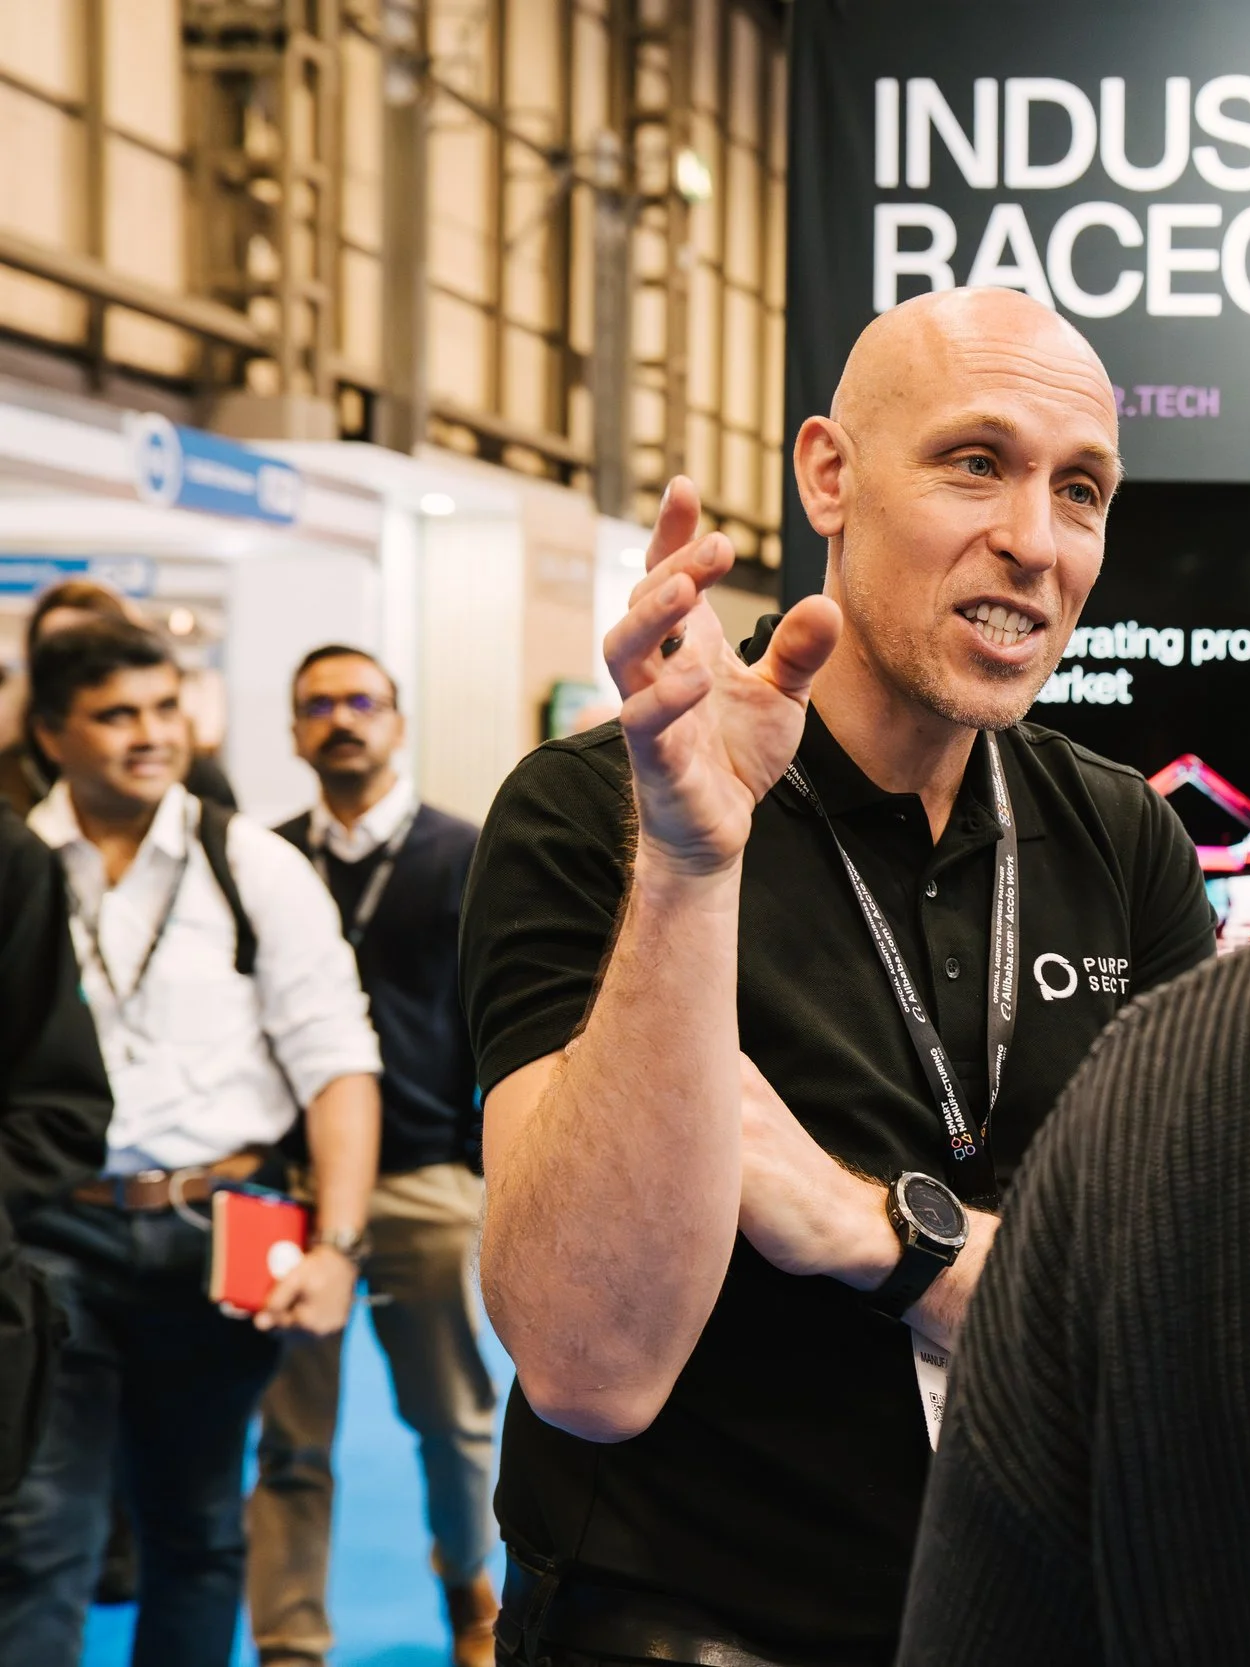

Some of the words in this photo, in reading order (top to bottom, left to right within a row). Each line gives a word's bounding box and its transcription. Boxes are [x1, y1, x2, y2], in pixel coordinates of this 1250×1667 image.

[1005, 854, 1015, 885] Work
[862, 902, 882, 940] BUSINESS
[996, 900, 1004, 936] BUSINESS
[878, 941, 896, 975] AGENTIC
[882, 928, 918, 1003] Alibaba.com
[994, 935, 1002, 969] AGENTIC
[1002, 930, 1014, 1002] Alibaba.com
[1083, 957, 1129, 975] PURP
[893, 977, 910, 1013] OFFICIAL
[1088, 975, 1130, 995] SECT
[930, 1047, 967, 1132] MANUFACTURING
[941, 1101, 958, 1136] SMART
[920, 1351, 948, 1369] MANUF
